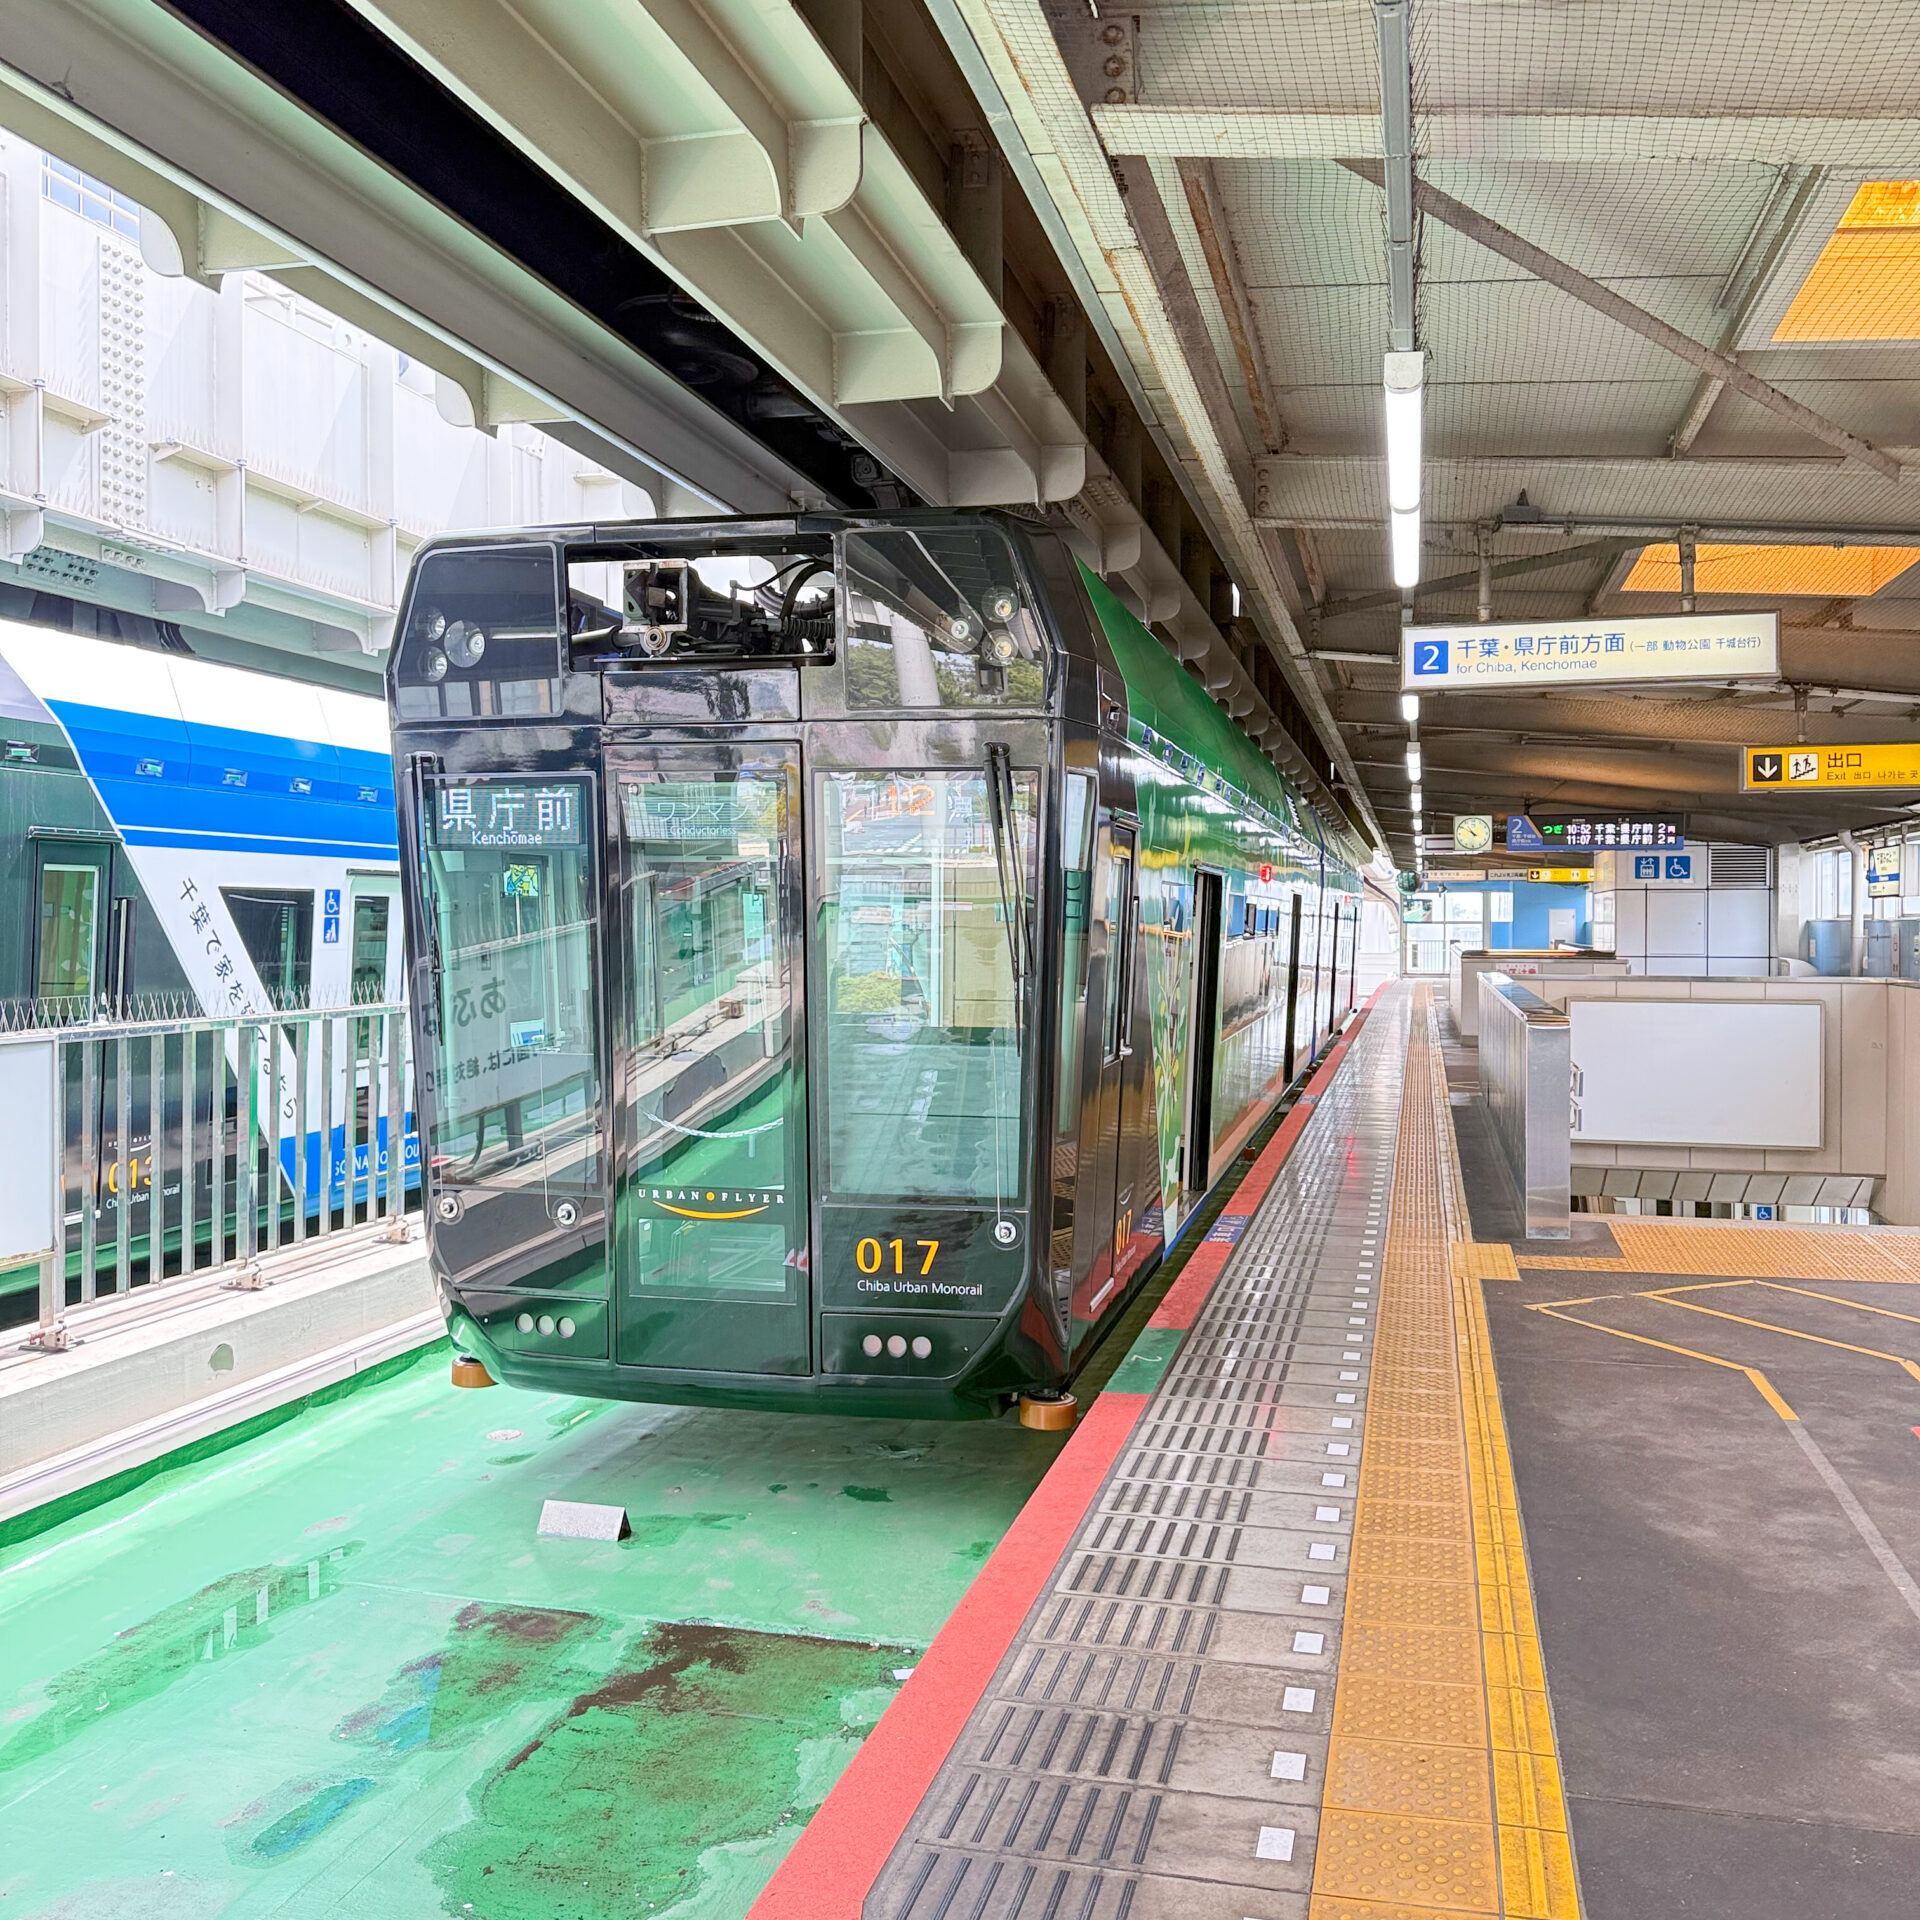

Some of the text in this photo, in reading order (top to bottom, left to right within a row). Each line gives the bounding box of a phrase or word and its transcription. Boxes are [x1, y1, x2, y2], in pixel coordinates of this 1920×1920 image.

[1457, 632, 1626, 659] 千葉・県庁前方面
[1422, 645, 1440, 671] 2
[1456, 664, 1473, 674] for
[1476, 661, 1517, 674] Chiba,
[1827, 752, 1862, 768] 出口
[1826, 771, 1847, 781] Exit
[1877, 769, 1907, 780] 나가는
[441, 787, 573, 832] 県庁前
[657, 802, 750, 822] ワンマン
[670, 825, 738, 837] Conductorless
[1511, 818, 1523, 834] 2
[1542, 824, 1564, 834] つぎ
[1566, 823, 1592, 834] 10:52
[1566, 834, 1592, 845] 11:07
[638, 1188, 785, 1204] URBAN FLYER
[1116, 1208, 1133, 1255] 017
[856, 1237, 940, 1275] 017
[857, 1279, 983, 1296] Chiba Urban Monorail
